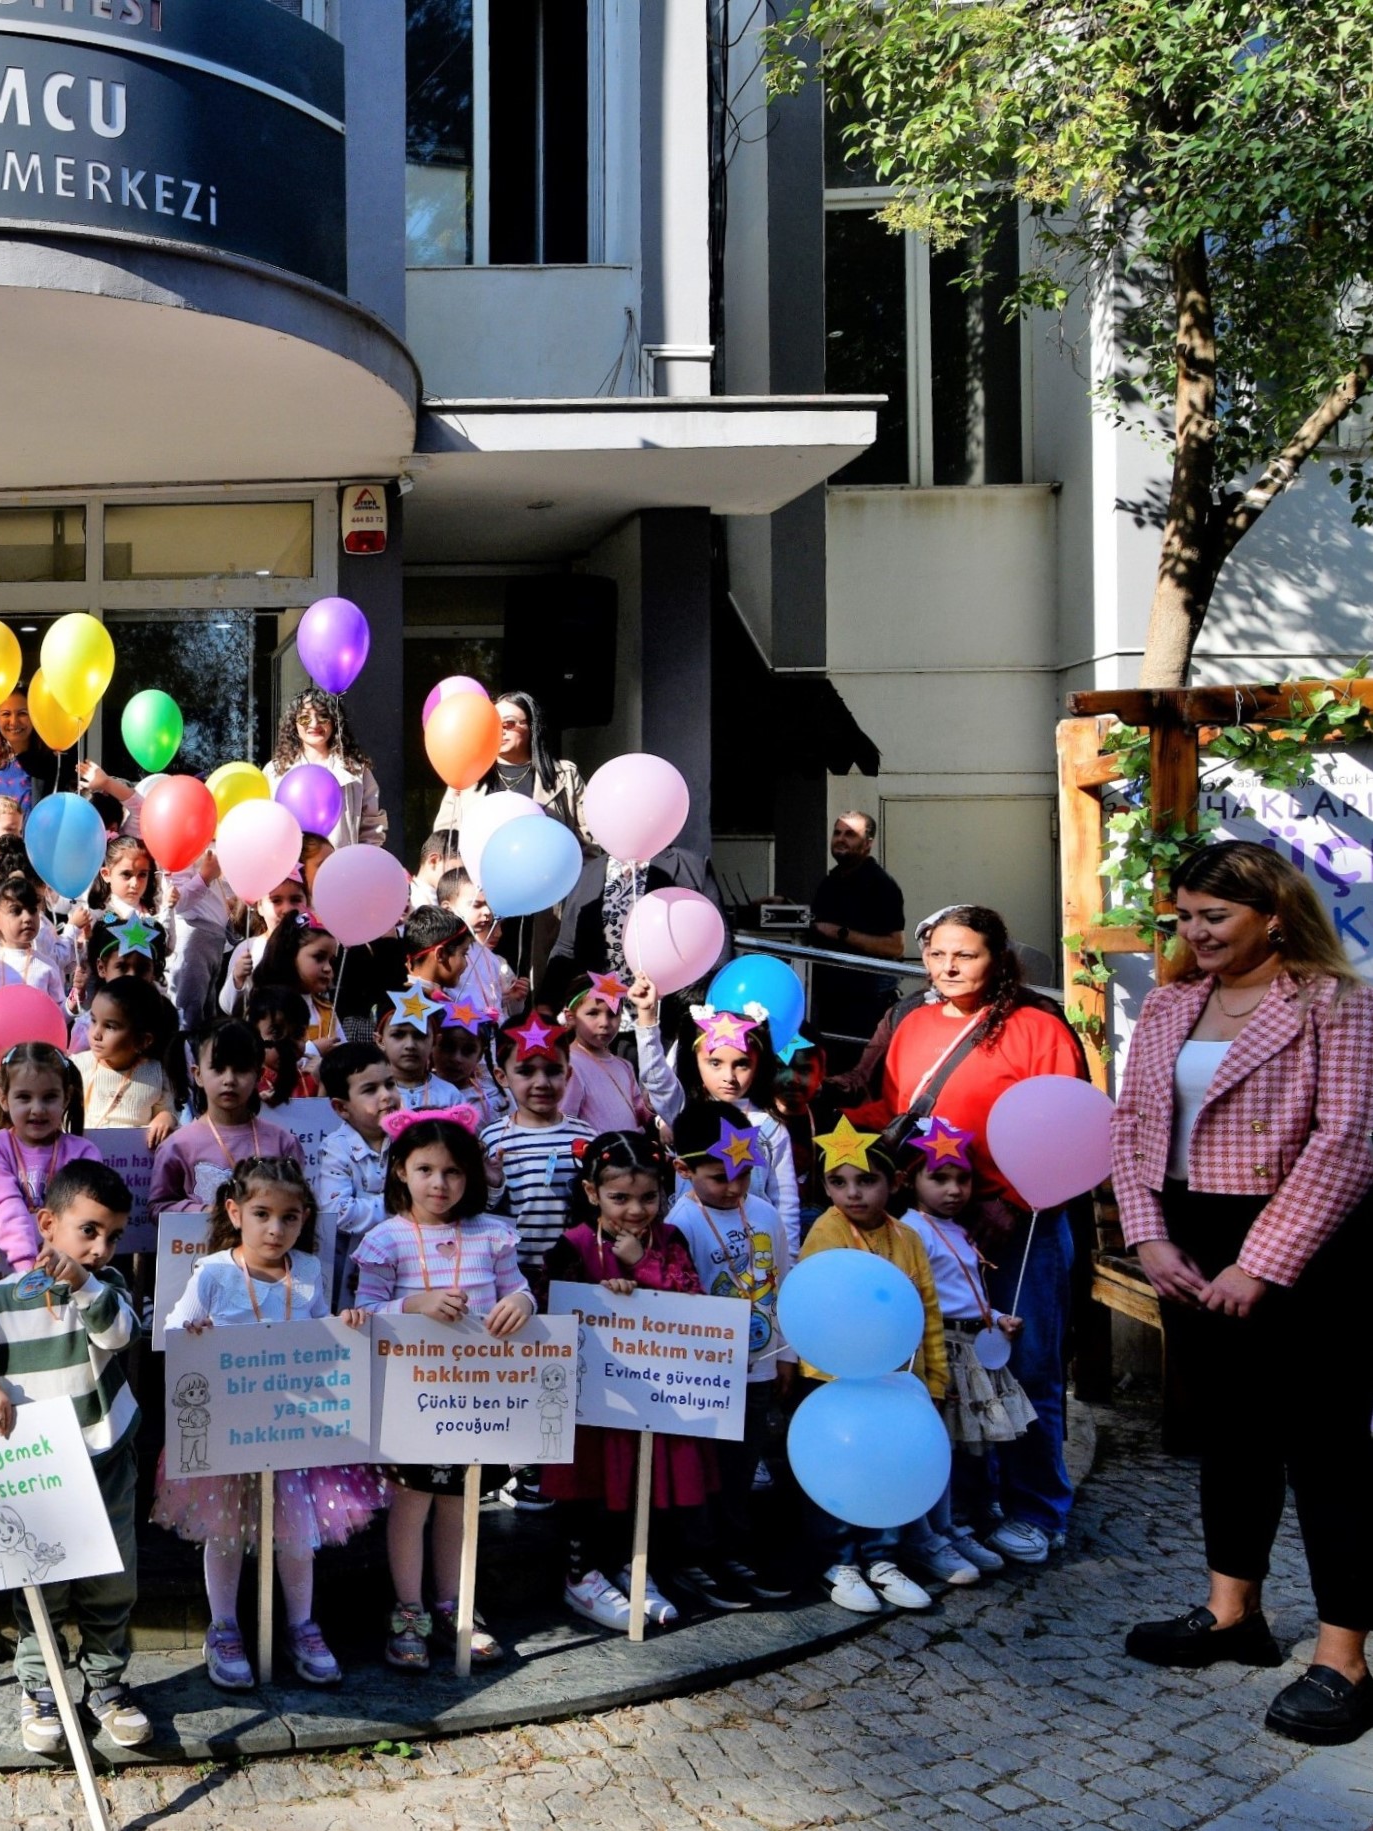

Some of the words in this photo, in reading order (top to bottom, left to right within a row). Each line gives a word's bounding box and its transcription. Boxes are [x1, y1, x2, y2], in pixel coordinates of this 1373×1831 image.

[642, 1316, 735, 1340] korunma
[219, 1349, 286, 1370] Benim
[293, 1344, 351, 1364] temiz
[378, 1339, 444, 1357] Benim
[452, 1340, 514, 1361] çocuk
[521, 1340, 572, 1357] olma
[612, 1337, 688, 1360] hakkım
[694, 1348, 733, 1364] var!
[227, 1377, 257, 1395] bir
[263, 1370, 351, 1393] dünyada
[413, 1366, 490, 1383] hakkım
[496, 1366, 536, 1383] var!
[604, 1363, 660, 1381] Evimde
[666, 1371, 731, 1388] güvende
[273, 1398, 351, 1420] yaşama
[417, 1393, 467, 1412] Çünkü
[473, 1396, 501, 1409] ben
[507, 1396, 529, 1409] bir
[650, 1390, 730, 1410] olmalıyım!
[229, 1425, 305, 1445] hakkım
[312, 1419, 351, 1437] var!
[435, 1417, 510, 1435] çocuğum!
